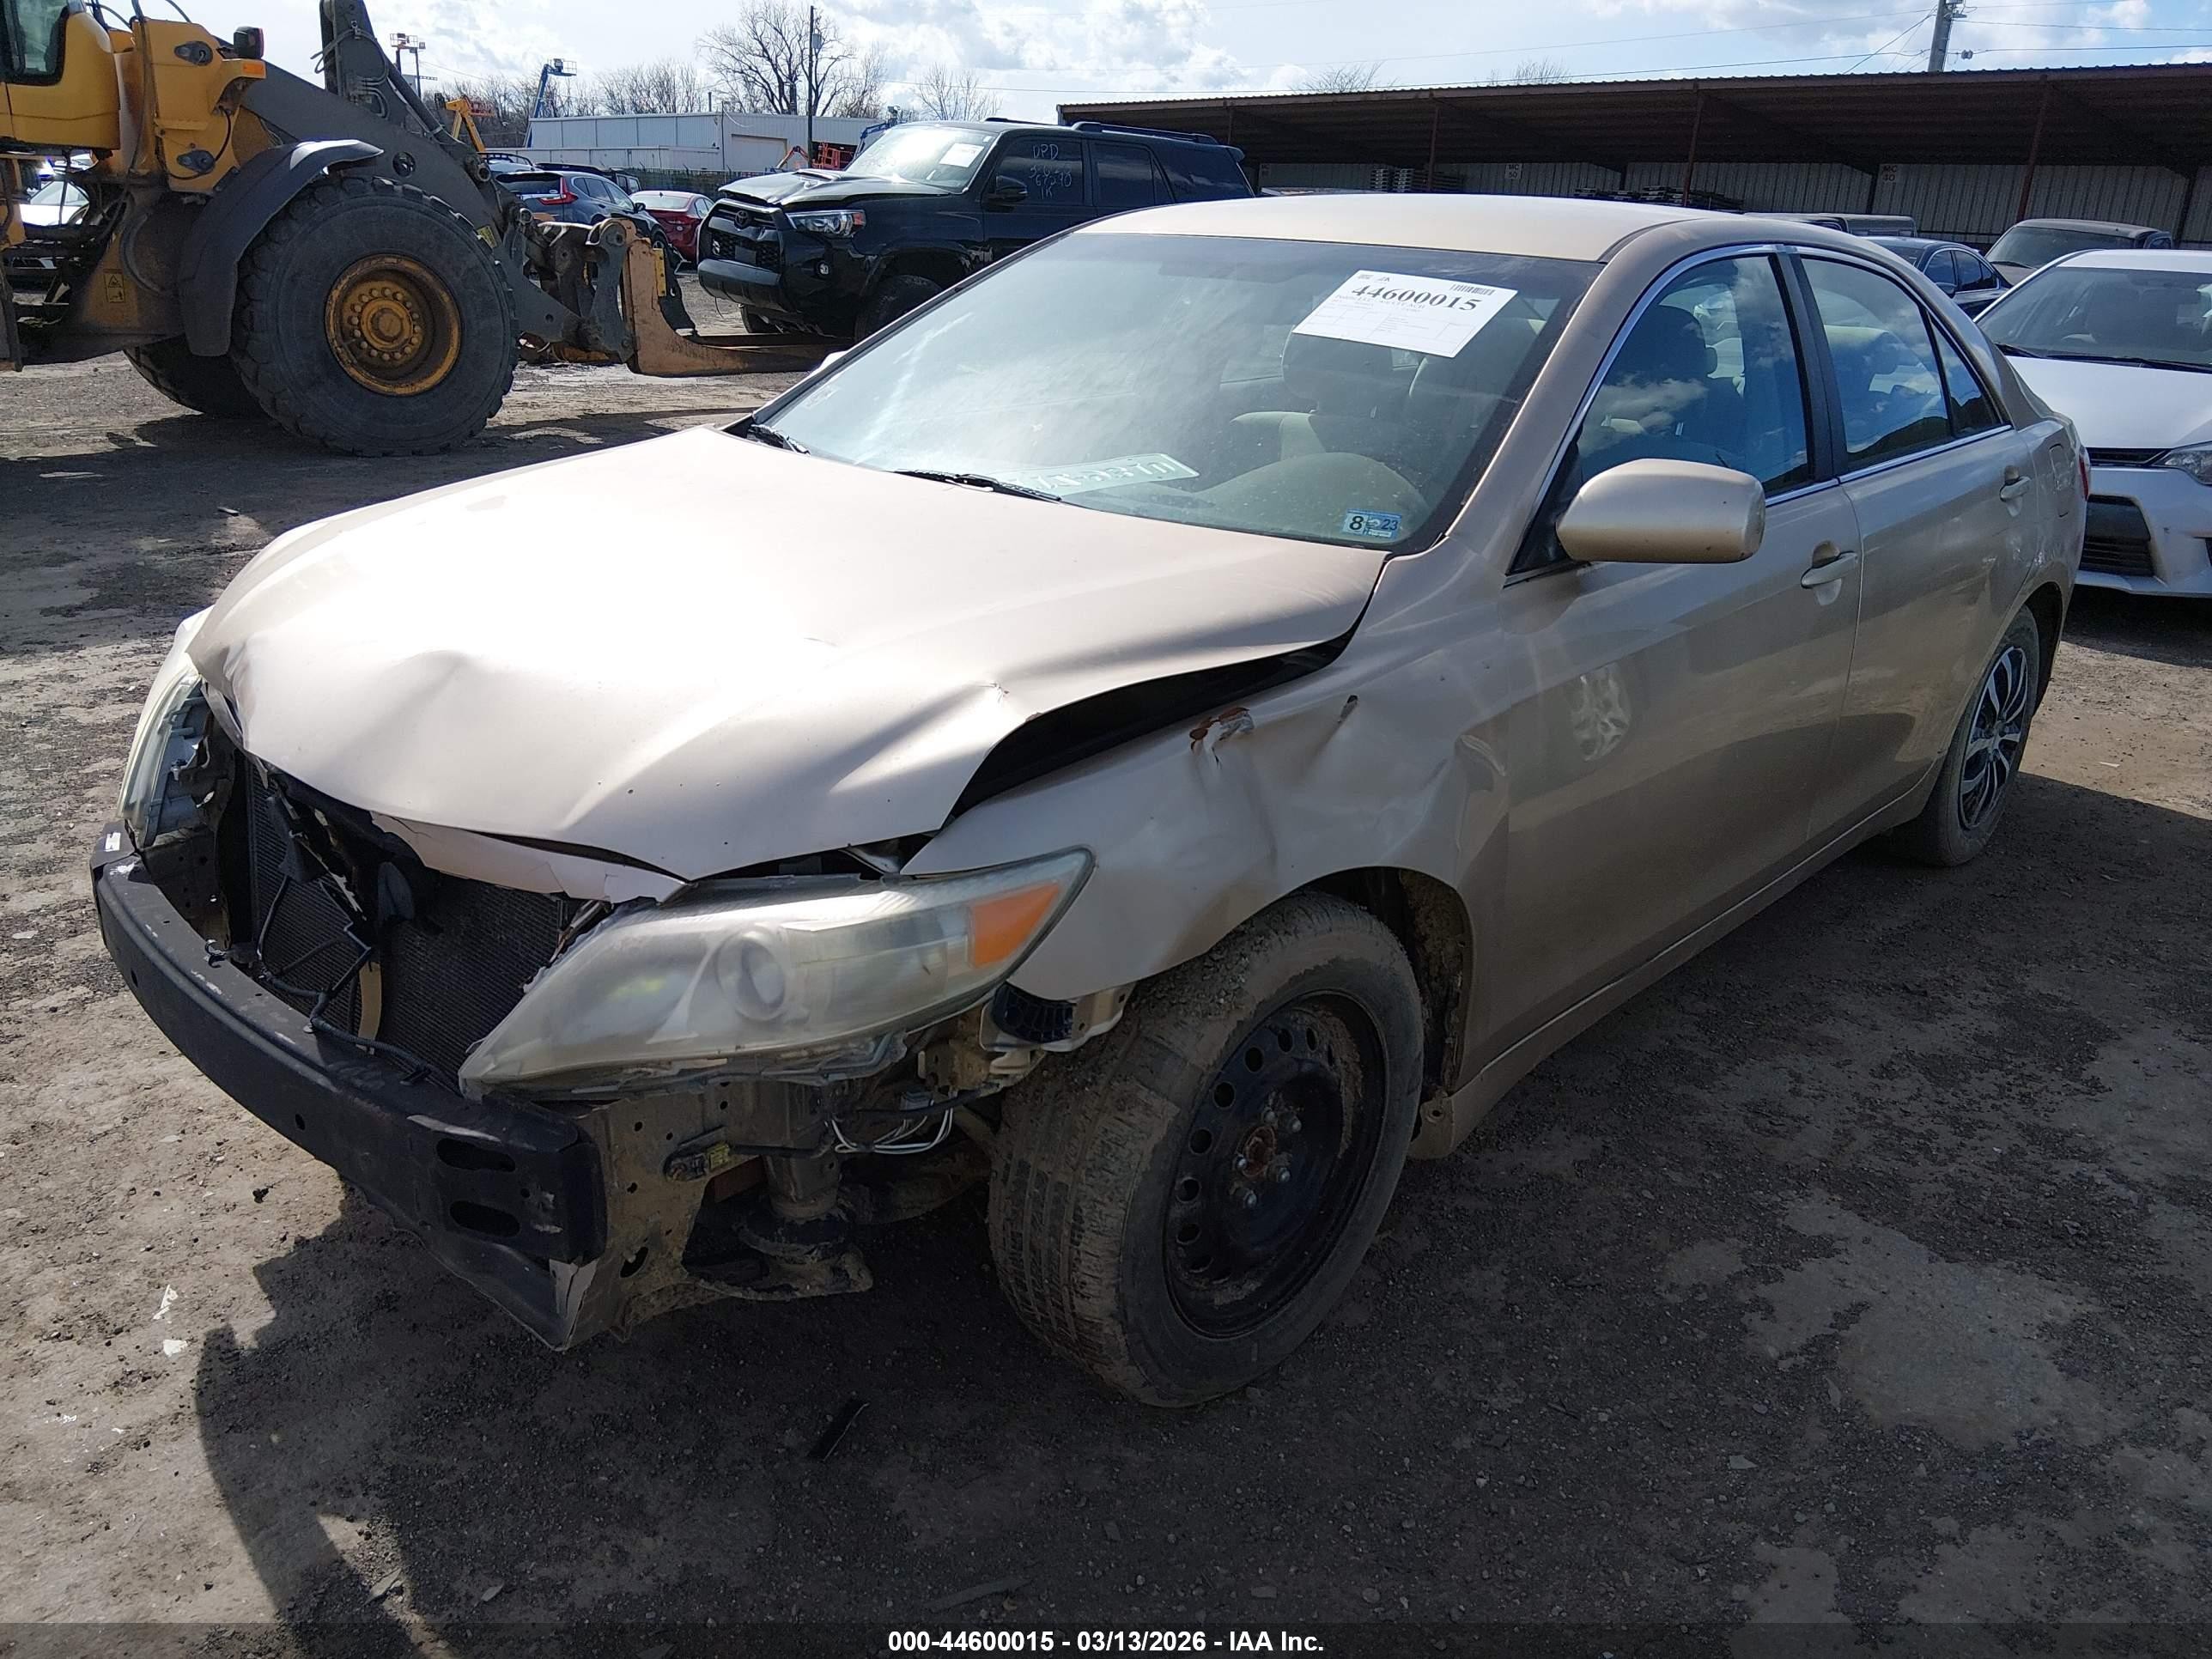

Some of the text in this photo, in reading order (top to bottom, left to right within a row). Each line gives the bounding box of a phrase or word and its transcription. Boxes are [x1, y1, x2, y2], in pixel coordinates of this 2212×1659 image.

[1351, 284, 1484, 312] 44600015
[1349, 515, 1399, 531] 8 23
